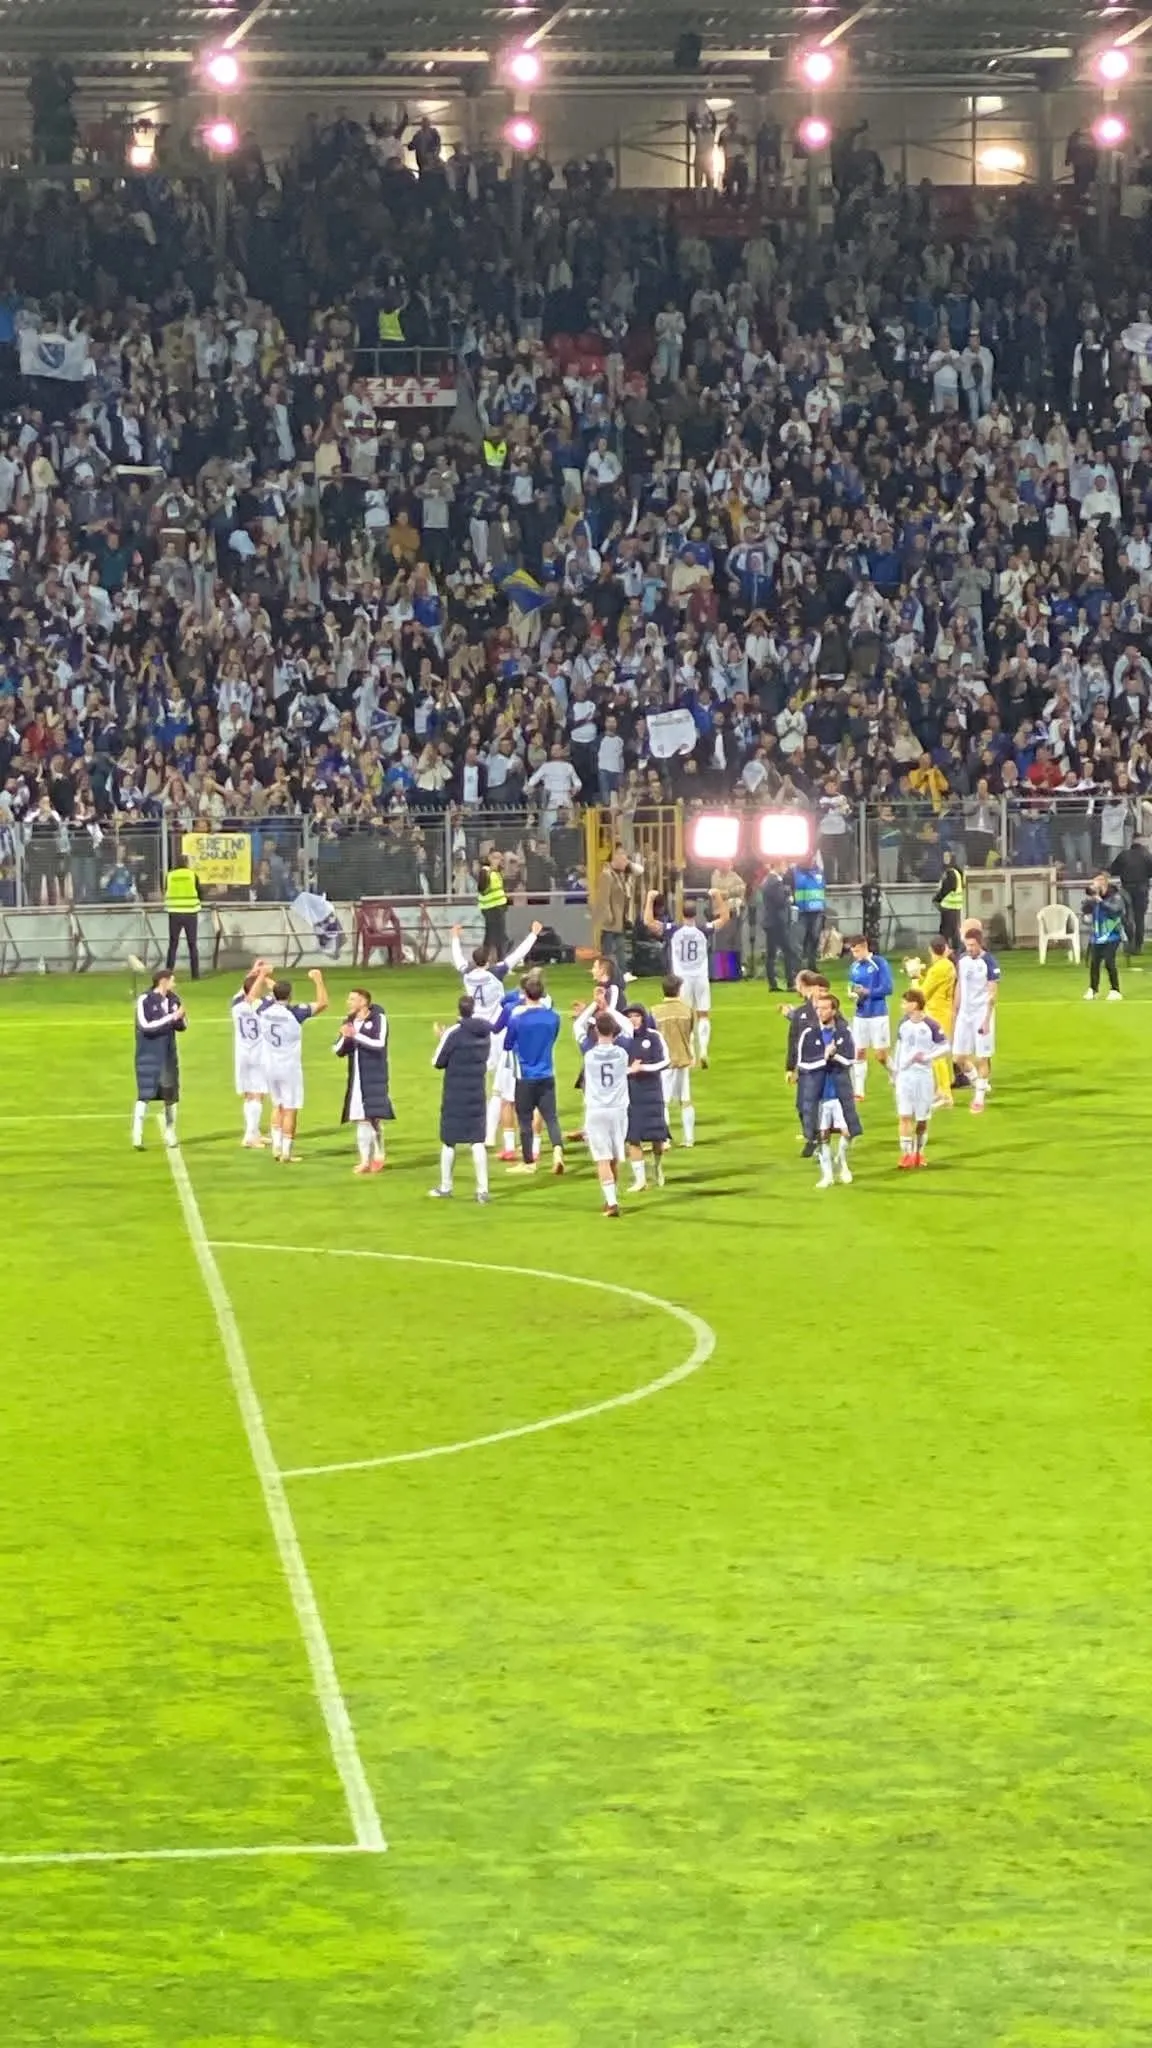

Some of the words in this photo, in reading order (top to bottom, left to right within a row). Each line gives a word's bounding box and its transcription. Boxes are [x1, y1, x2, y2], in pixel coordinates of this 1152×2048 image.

[365, 377, 441, 389] ZLAZ
[680, 940, 697, 961] 18
[473, 984, 487, 1008] 4
[238, 1016, 259, 1040] 13
[270, 1023, 282, 1048] 5
[600, 1063, 614, 1087] 6
